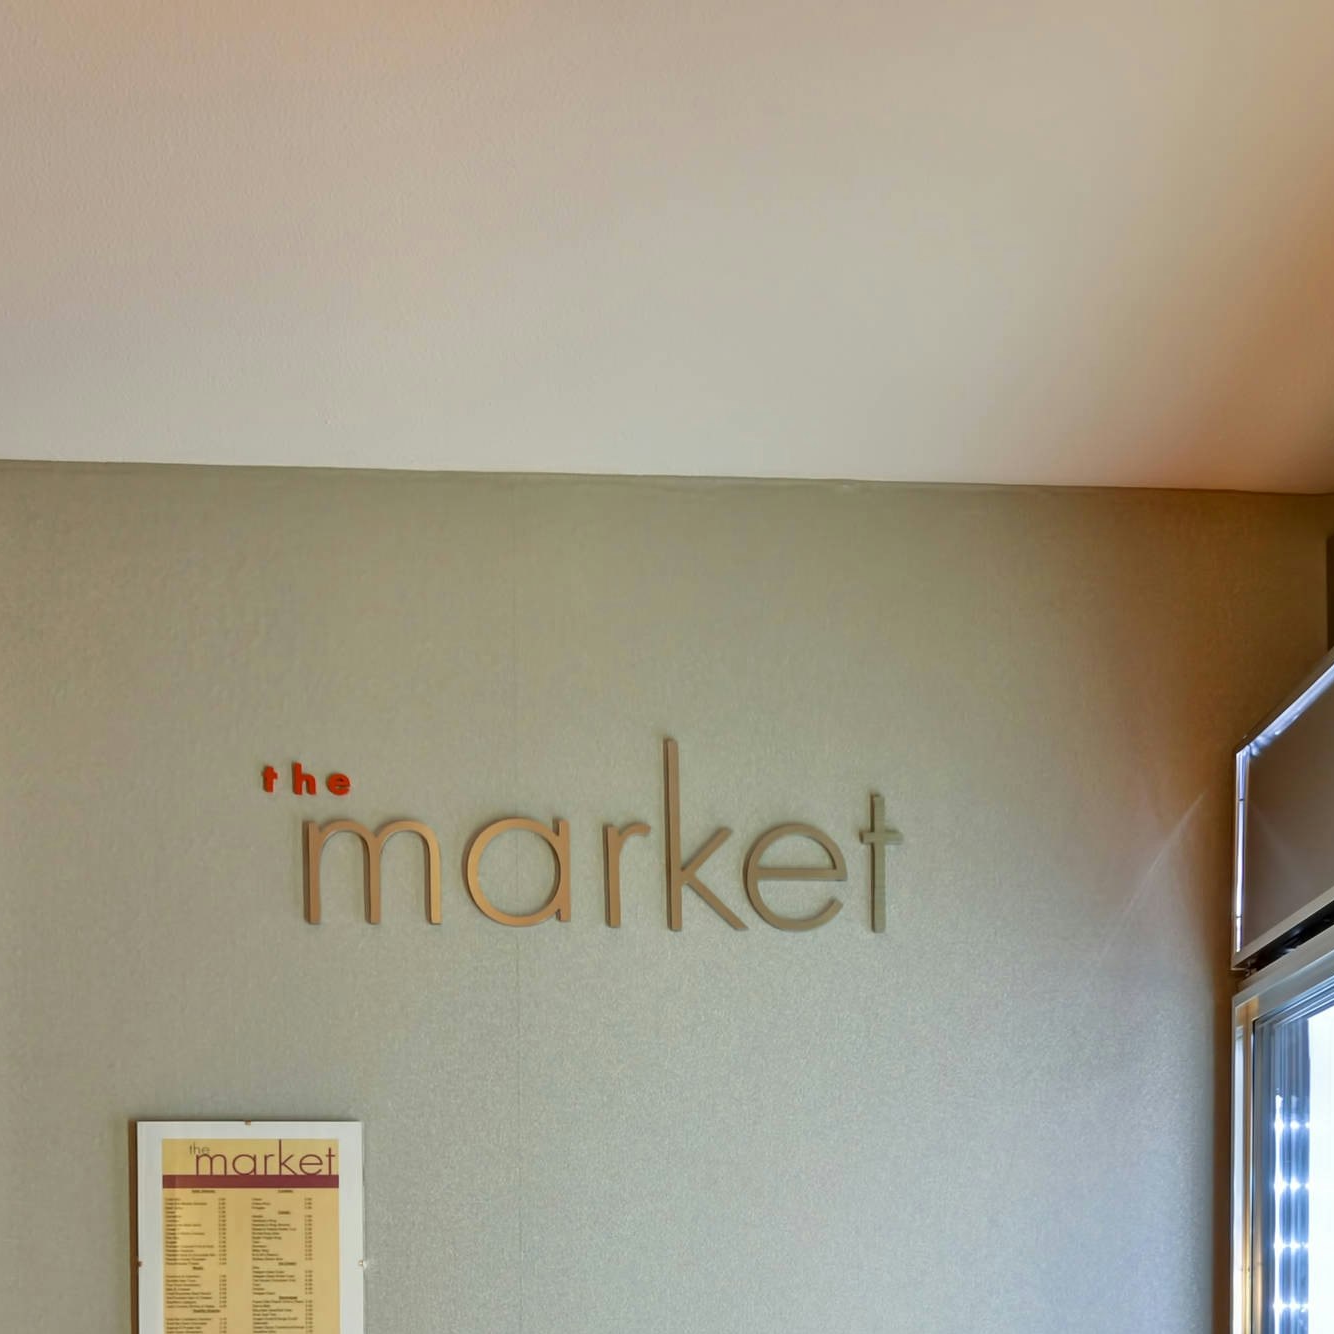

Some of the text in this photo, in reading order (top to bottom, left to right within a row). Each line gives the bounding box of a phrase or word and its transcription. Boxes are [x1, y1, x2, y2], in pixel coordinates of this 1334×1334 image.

[263, 762, 351, 796] the
[303, 738, 903, 933] market
[189, 1141, 211, 1155] the
[195, 1139, 336, 1176] market
